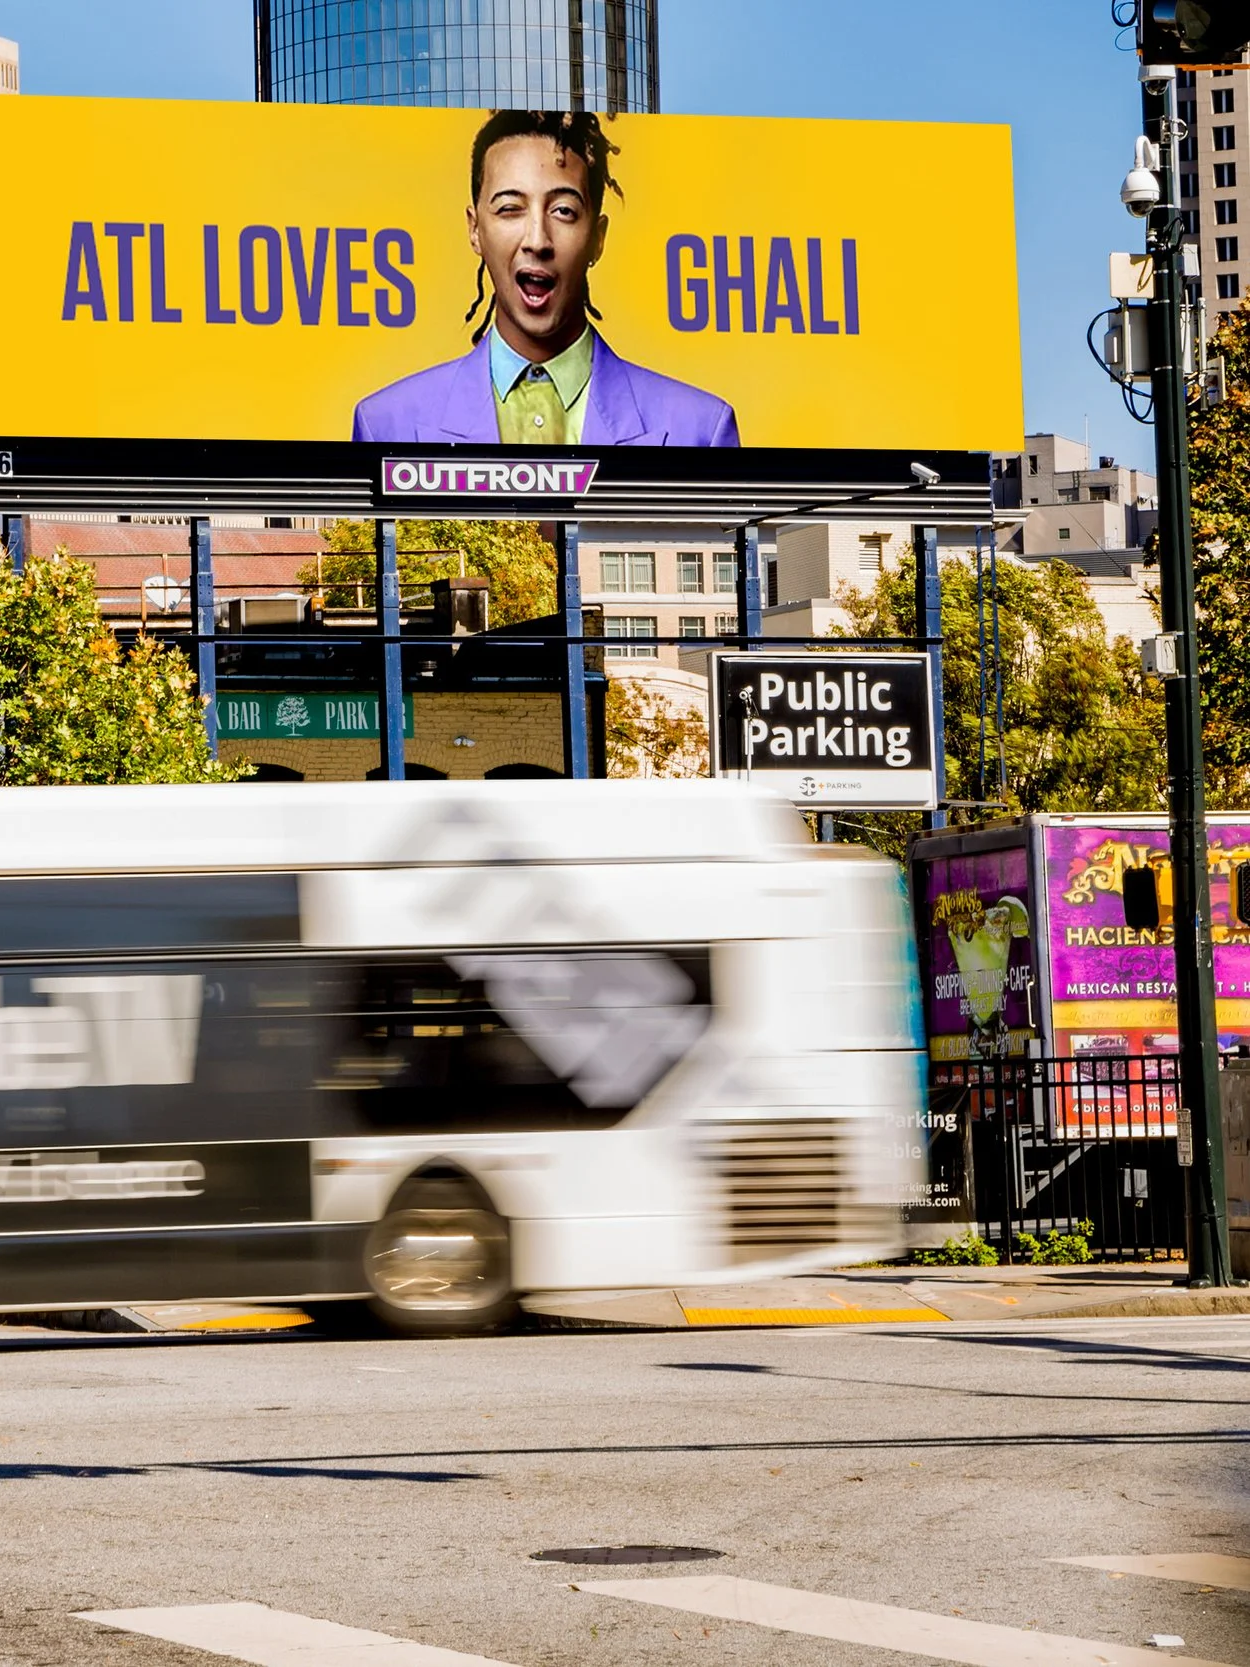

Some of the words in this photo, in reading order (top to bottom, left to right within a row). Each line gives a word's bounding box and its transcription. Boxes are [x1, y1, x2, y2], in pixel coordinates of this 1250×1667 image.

[62, 221, 182, 323] ATL
[203, 224, 416, 328] LOVES
[666, 234, 860, 335] GHALI
[391, 462, 585, 492] OUTFRONT
[760, 671, 892, 711] Public
[228, 701, 261, 730] BAR
[325, 701, 368, 730] PARK
[744, 716, 912, 767] Parking
[1066, 926, 1174, 946] HACIEN
[935, 973, 971, 999] SHOPPING
[978, 969, 1003, 993] DINING
[1010, 965, 1030, 991] CAFE
[1066, 982, 1130, 994] MEXICAN
[883, 1110, 958, 1132] Parking
[1073, 1103, 1080, 1112] 4
[1083, 1103, 1122, 1112] blocs
[892, 1182, 932, 1194] Parking
[934, 1183, 949, 1192] at:
